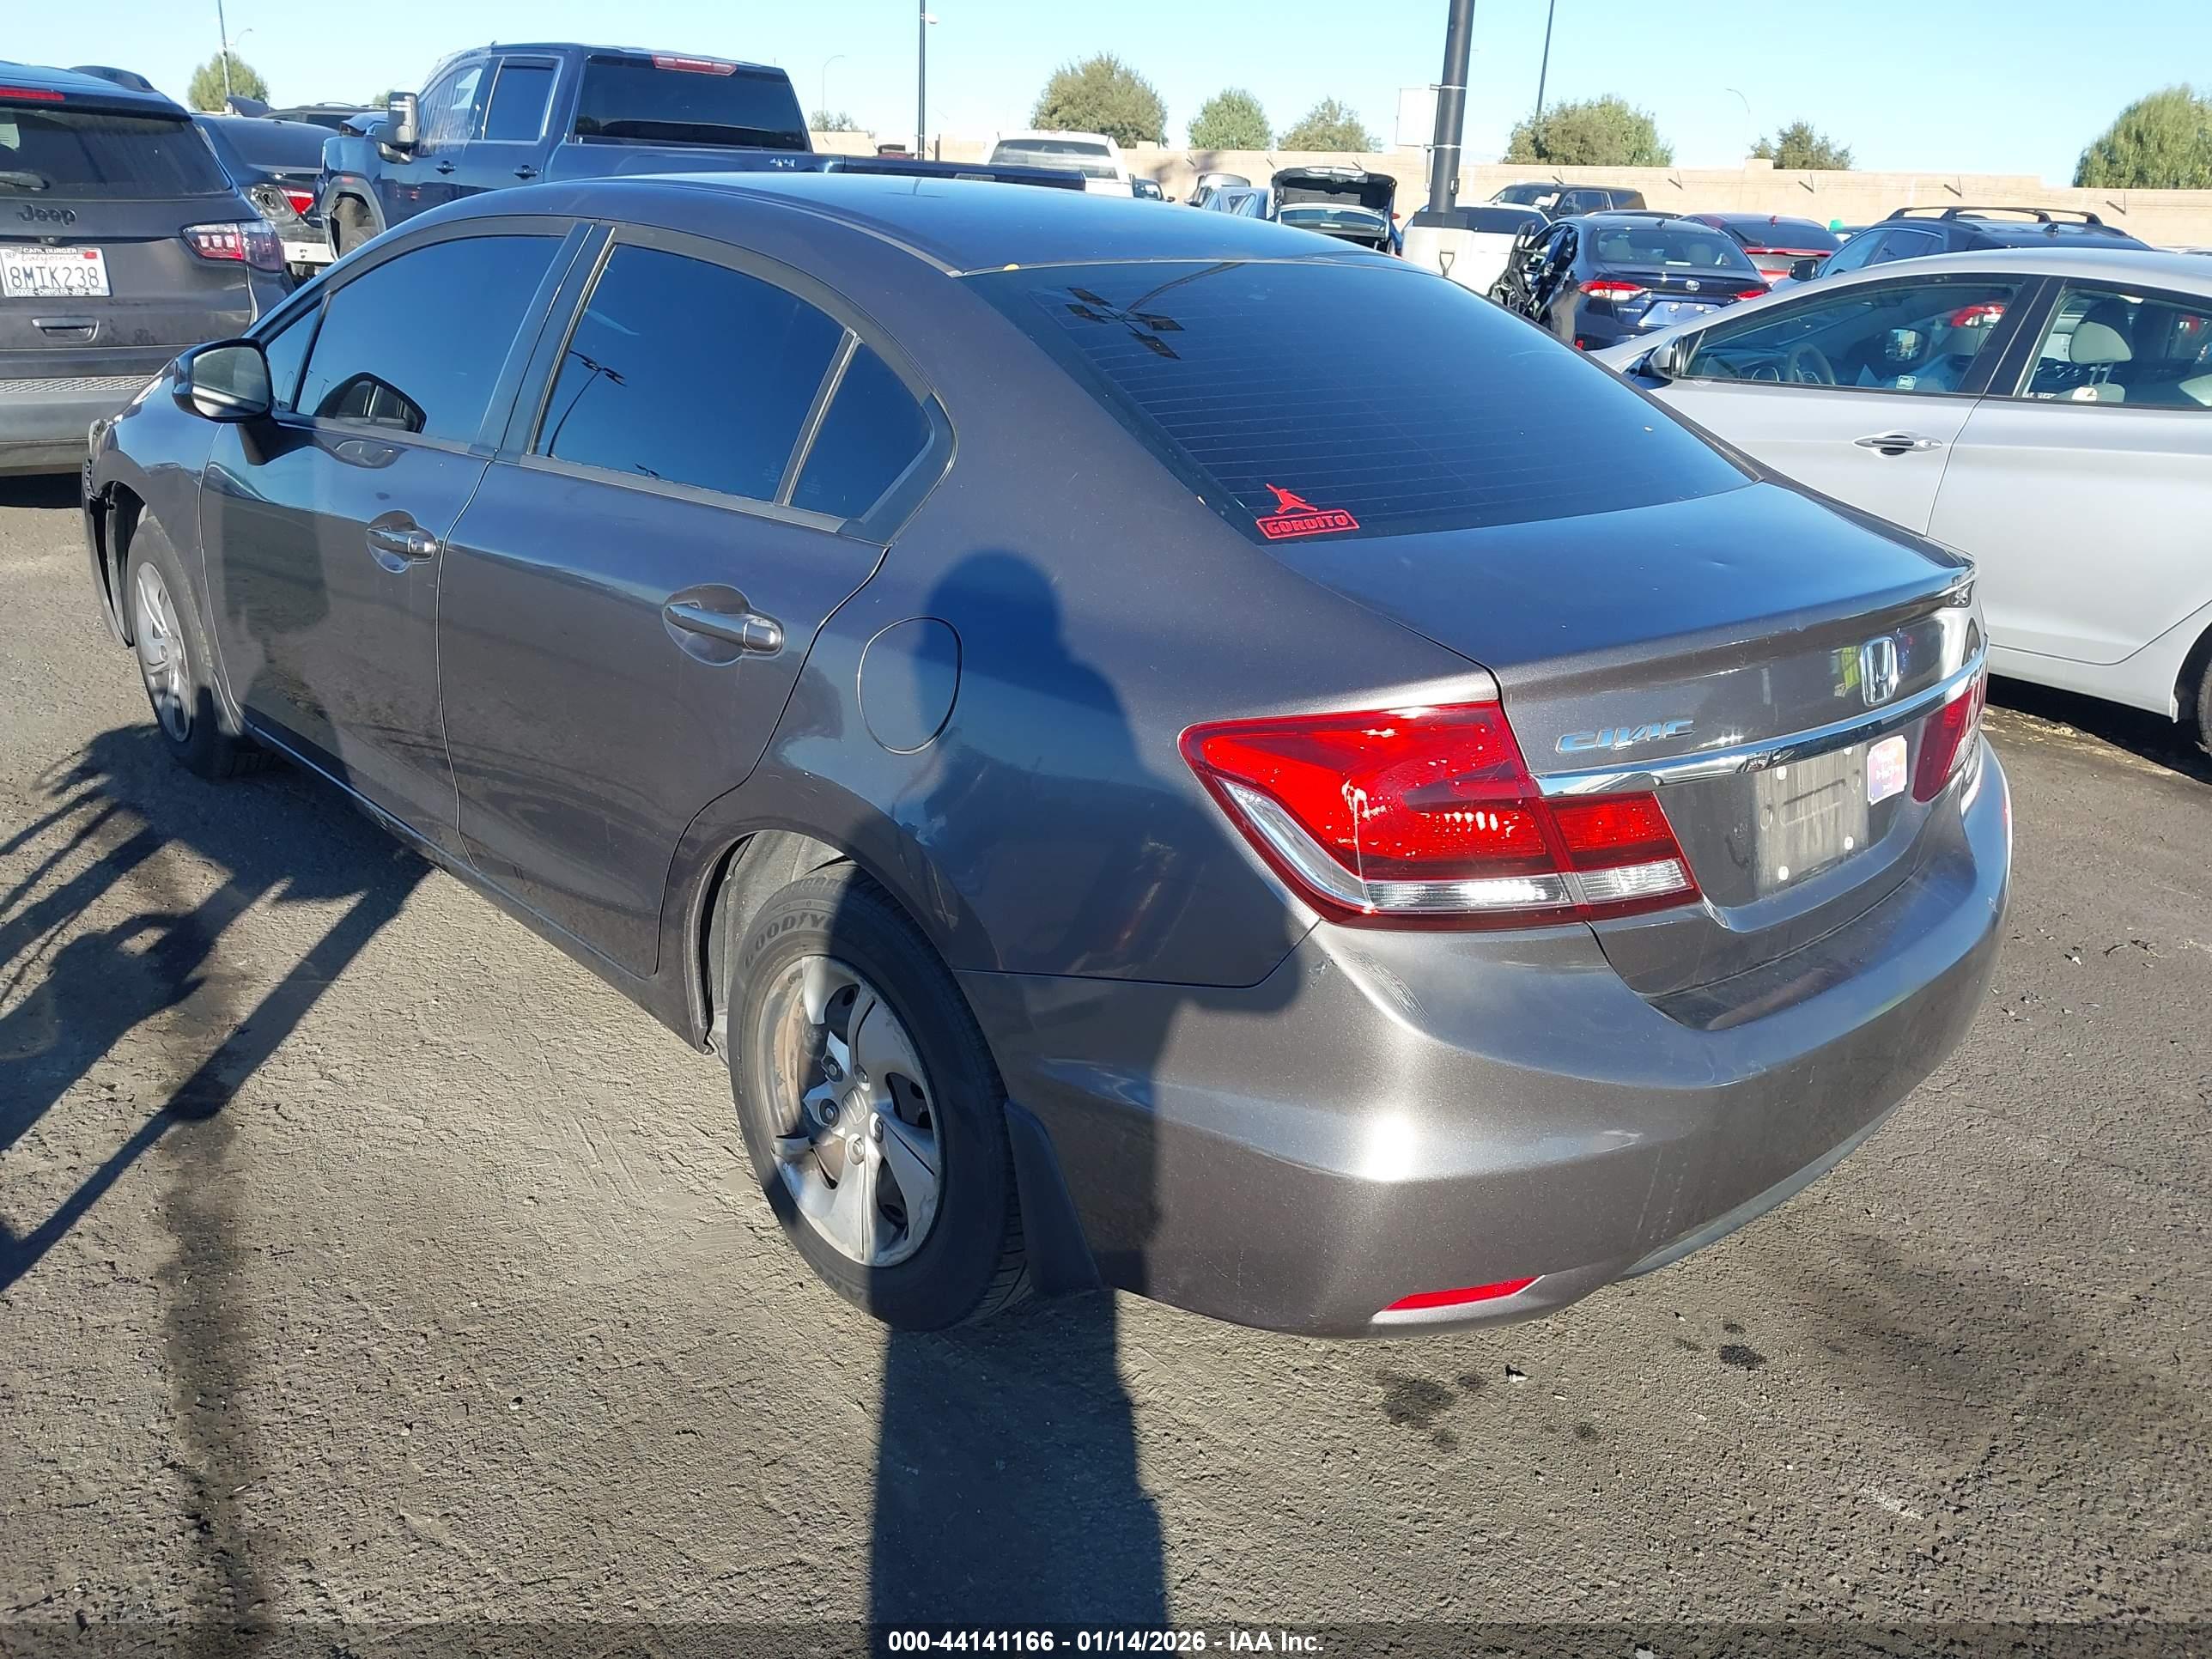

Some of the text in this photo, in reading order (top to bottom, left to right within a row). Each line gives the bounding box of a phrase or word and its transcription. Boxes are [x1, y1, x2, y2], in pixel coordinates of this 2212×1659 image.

[15, 204, 76, 227] Jeep
[9, 266, 100, 289] 8MIK238
[1266, 515, 1348, 533] GORDITO
[1555, 720, 1695, 754] CIVIC
